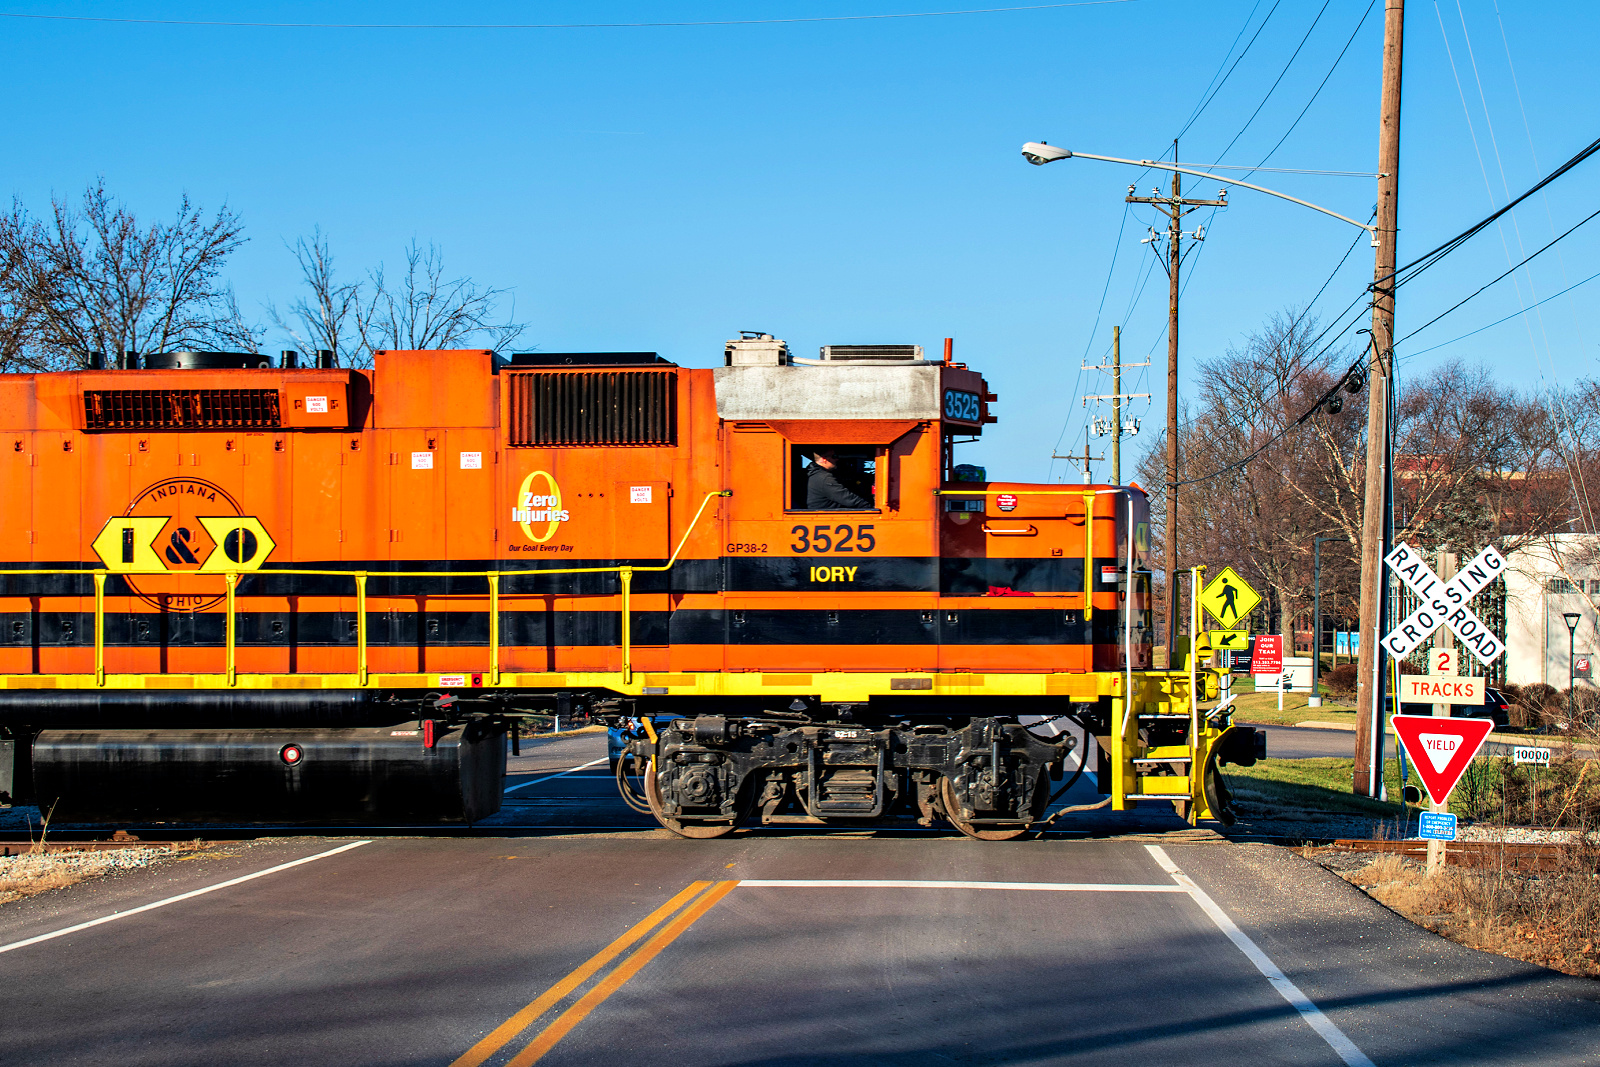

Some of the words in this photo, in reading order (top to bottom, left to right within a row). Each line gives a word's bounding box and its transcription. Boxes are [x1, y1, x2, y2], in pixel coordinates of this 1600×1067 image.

[945, 391, 980, 420] 3525
[151, 485, 216, 503] INDIANA
[523, 491, 558, 508] Zero
[512, 507, 570, 525] Injuries
[790, 524, 876, 553] 3525
[508, 544, 521, 552] Our
[522, 544, 539, 552] Goal
[540, 544, 560, 553] Every
[561, 544, 574, 552] Day
[726, 543, 768, 554] GP38-2
[809, 565, 858, 583] IORY
[163, 594, 204, 608] OHIO
[1388, 551, 1502, 656] CROSSING
[1388, 547, 1439, 601] RAIL
[1448, 607, 1498, 662] ROAD
[1438, 653, 1449, 671] 2
[1113, 678, 1119, 687] F
[1412, 683, 1473, 697] TRACKS
[1426, 739, 1455, 751] YIELD
[1516, 749, 1549, 760] 10000
